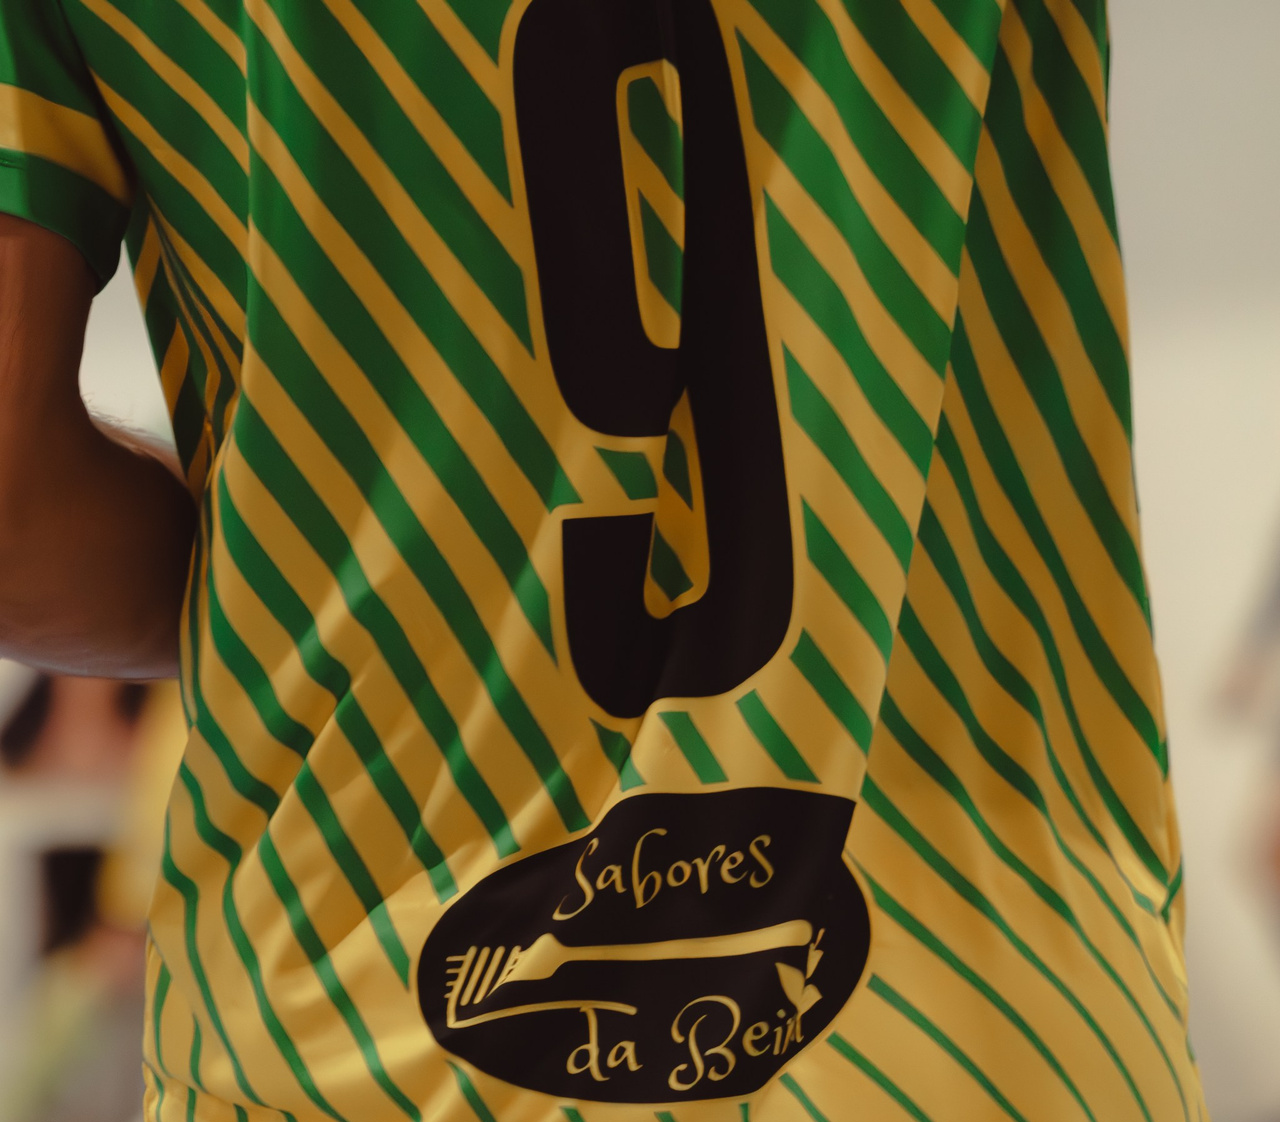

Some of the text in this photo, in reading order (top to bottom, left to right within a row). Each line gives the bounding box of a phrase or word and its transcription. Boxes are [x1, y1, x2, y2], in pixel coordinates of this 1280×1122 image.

[513, 0, 795, 720] 9
[552, 827, 775, 921] Sabores
[566, 1004, 644, 1082] da
